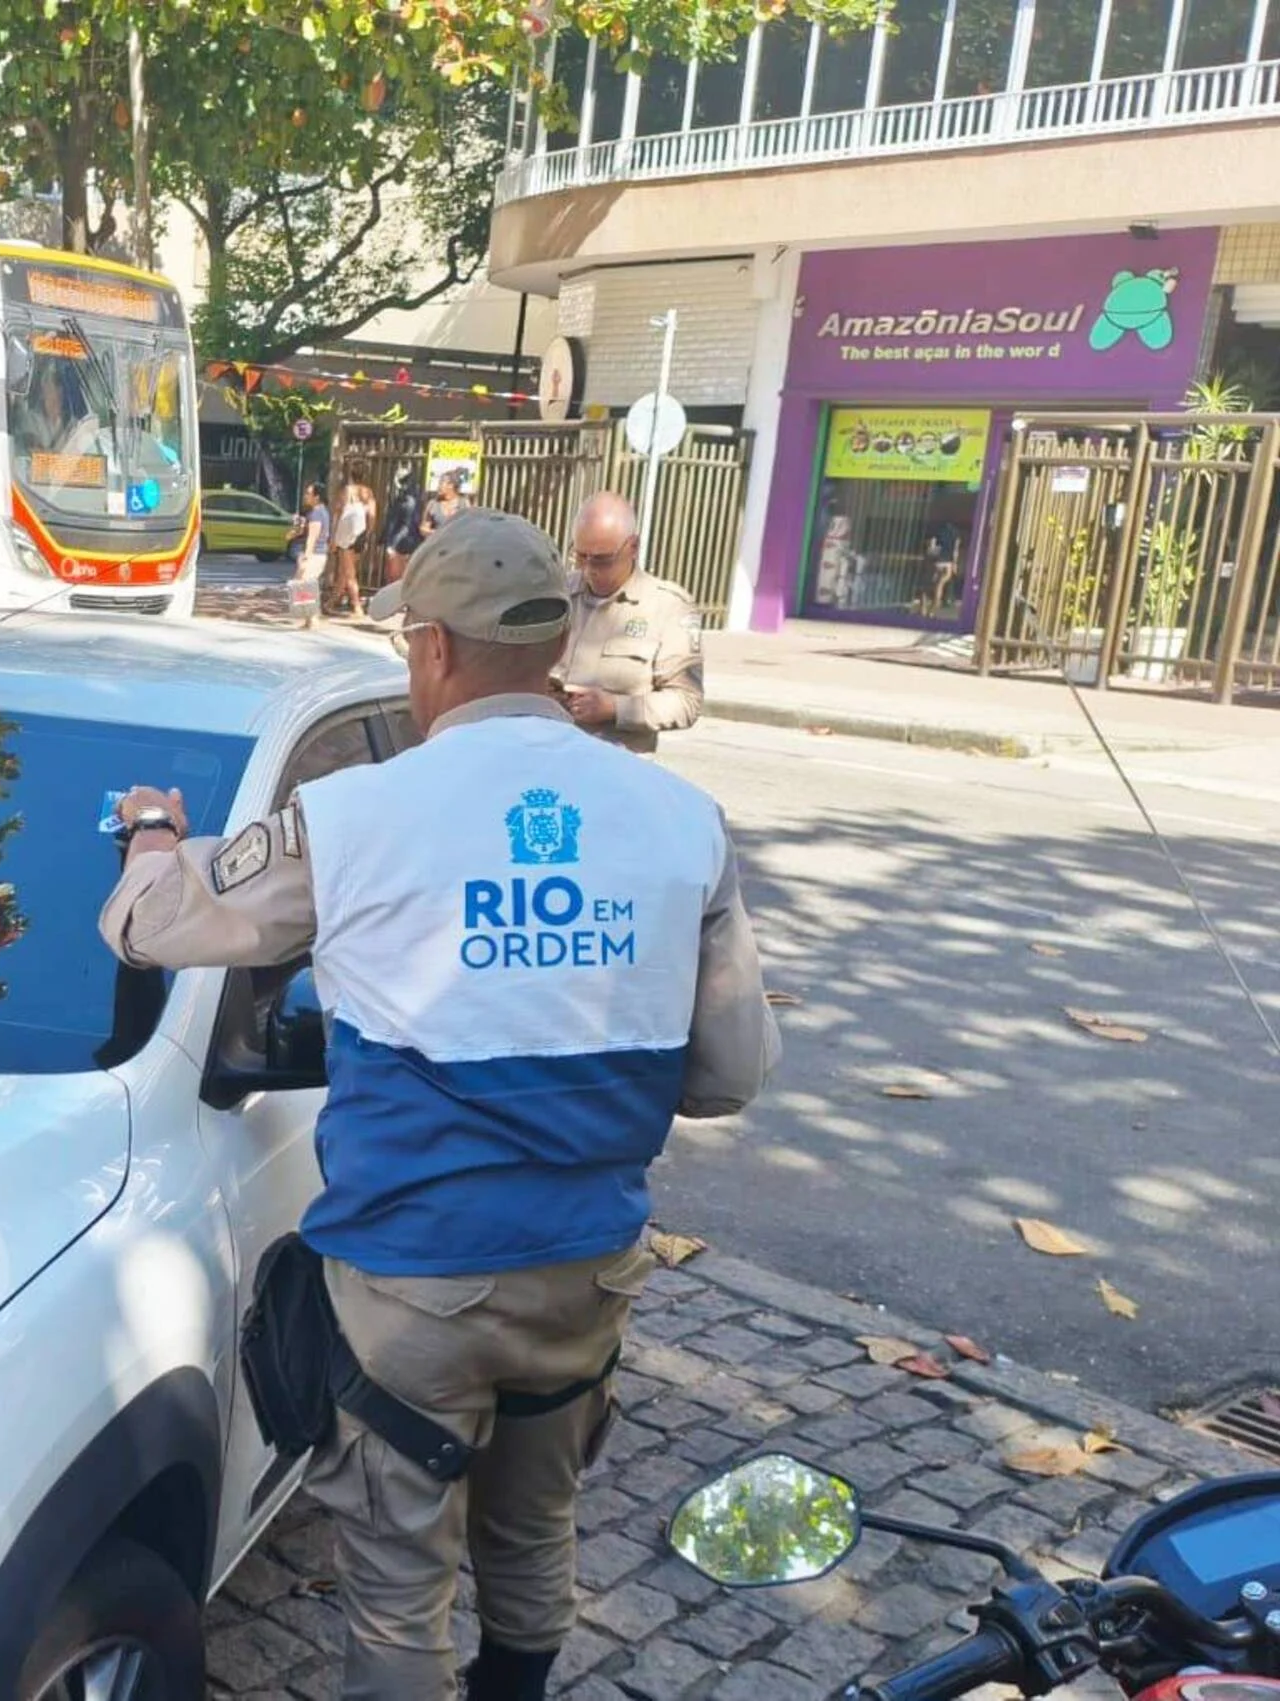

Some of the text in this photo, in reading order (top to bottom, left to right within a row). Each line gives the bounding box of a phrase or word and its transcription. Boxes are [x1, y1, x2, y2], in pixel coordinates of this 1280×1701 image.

[841, 345, 870, 361] The
[873, 344, 911, 360] best
[955, 343, 972, 360] in
[976, 343, 1005, 360] the
[464, 875, 634, 929] RIO EM
[460, 929, 635, 969] ORDEM
